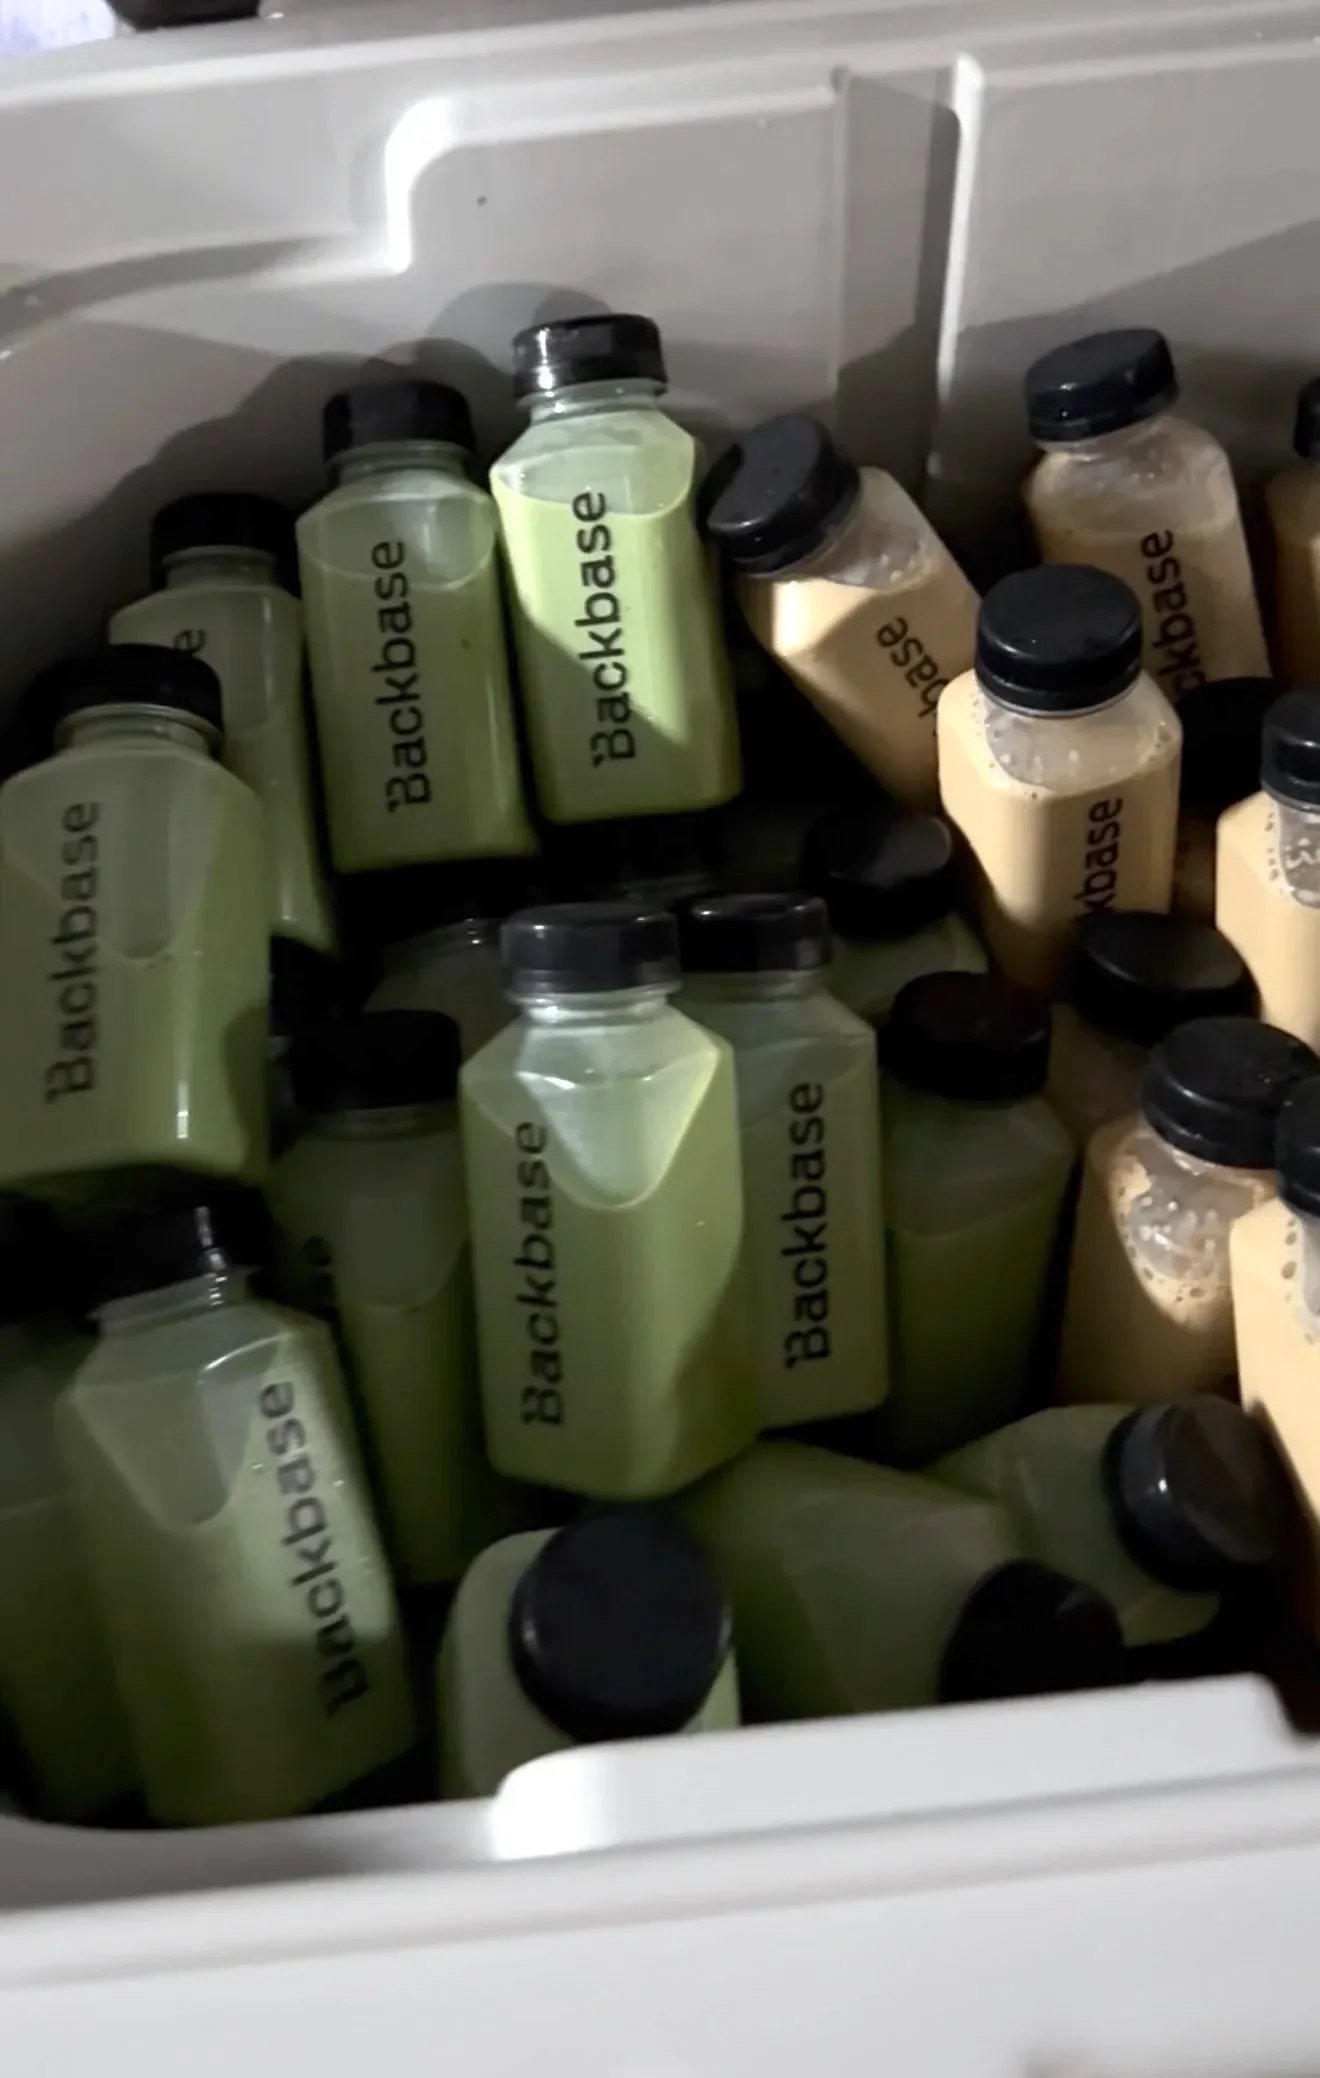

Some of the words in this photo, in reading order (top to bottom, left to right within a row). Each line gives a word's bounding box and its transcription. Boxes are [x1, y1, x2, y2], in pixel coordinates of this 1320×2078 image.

[370, 540, 432, 813] Backbase
[572, 490, 637, 769] Backbase
[1140, 529, 1206, 700] ckbase
[46, 801, 100, 1104] Backbase
[512, 1121, 565, 1429] Backbase
[781, 1082, 830, 1369] Backbase
[258, 1380, 370, 1717] Backbase
